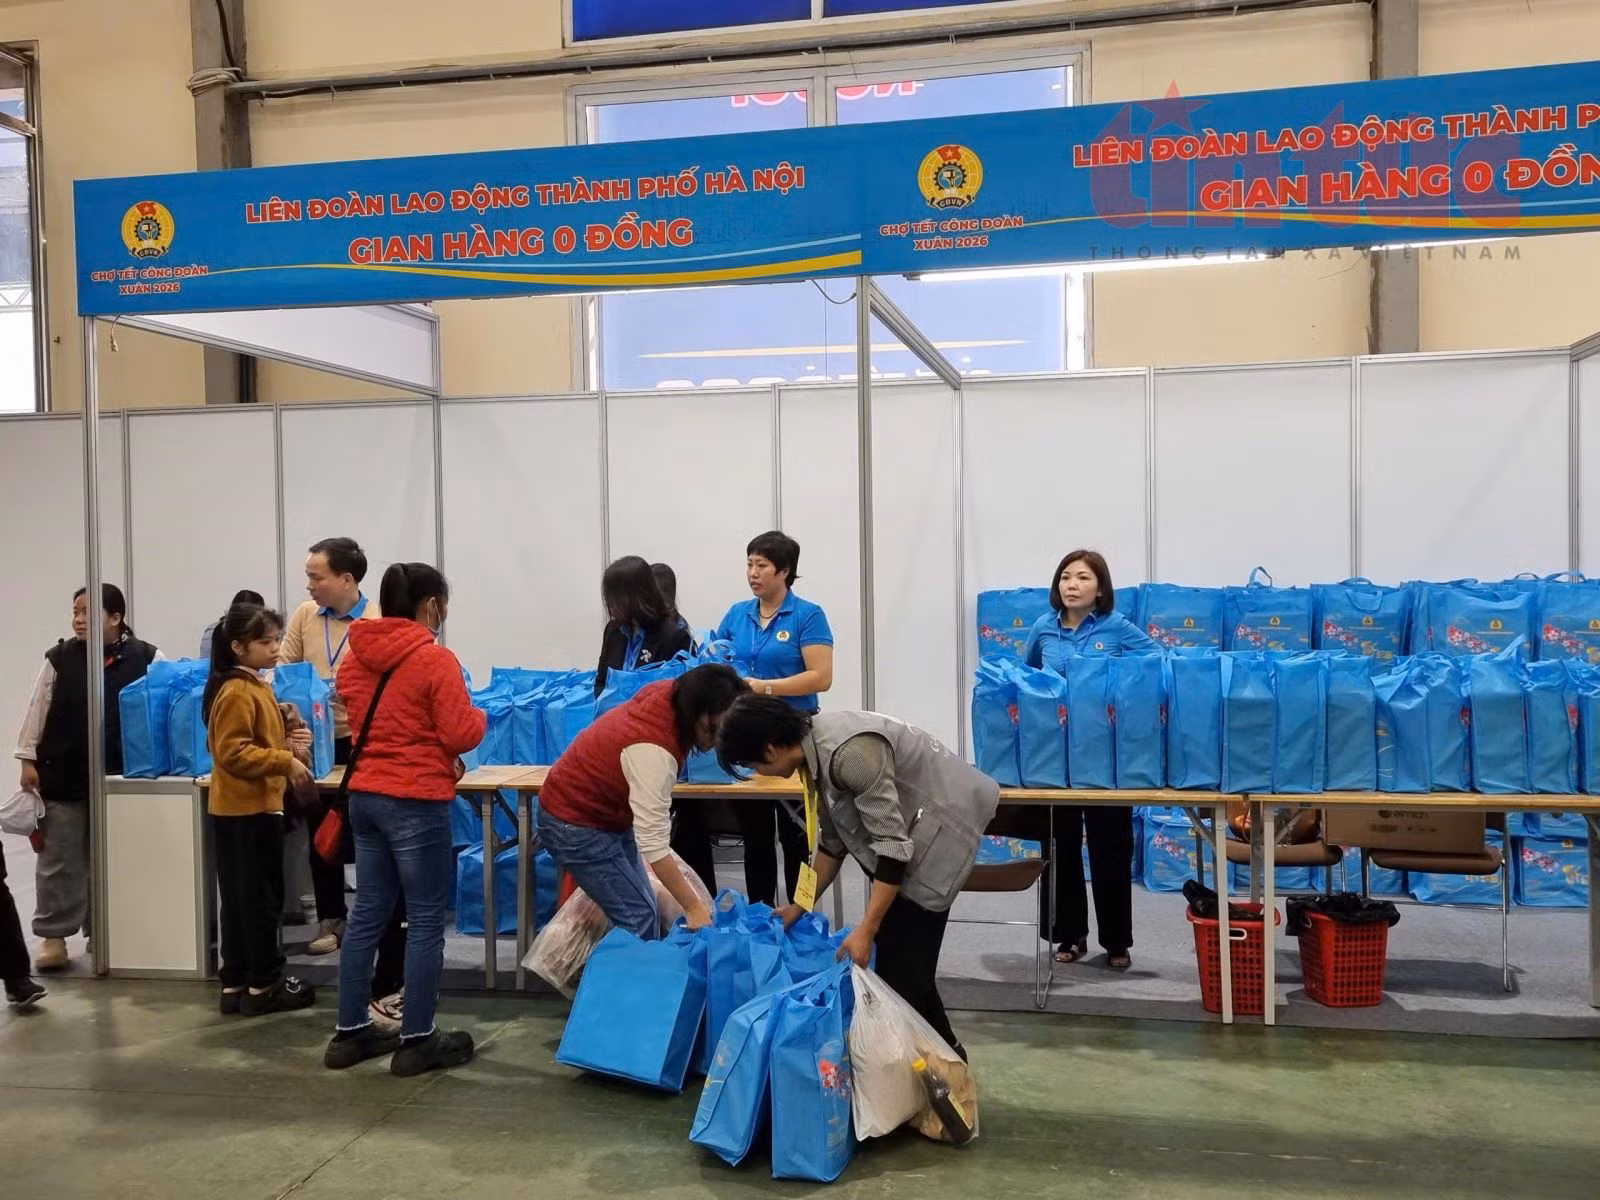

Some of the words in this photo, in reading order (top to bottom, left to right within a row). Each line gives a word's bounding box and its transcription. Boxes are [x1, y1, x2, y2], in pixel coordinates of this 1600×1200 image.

[1073, 136, 1143, 168] LIÊN
[1149, 128, 1247, 162] ĐOÀN
[1256, 126, 1325, 154] LAO
[1331, 115, 1435, 152] ĐỘNG
[1442, 105, 1567, 140] THÀNH
[245, 196, 302, 224] LIÊN
[307, 191, 384, 220] ĐOÀN
[390, 191, 445, 215] LAO
[450, 183, 530, 215] ĐỘNG
[535, 176, 631, 206] THÀNH
[638, 165, 700, 199] PHỐ
[705, 165, 748, 195] HÀ
[753, 161, 805, 195] NỘI
[1200, 174, 1308, 212] GIAN
[1320, 162, 1452, 204] HÀNG
[1463, 160, 1493, 193] 0
[349, 233, 433, 265] GIAN
[442, 224, 544, 260] HÀNG
[553, 225, 576, 253] 0
[584, 212, 694, 252] ĐỒNG
[880, 222, 910, 237] CHỢ
[911, 219, 937, 234] TẾT
[939, 218, 979, 232] CÔNG
[981, 214, 1024, 230] ĐOÀN
[914, 236, 954, 251] XUÂN
[956, 235, 988, 248] 2026
[91, 269, 115, 283] CHỢ
[117, 266, 138, 280] TẾT
[140, 266, 173, 279] CÔNG
[174, 263, 208, 278] ĐOÀN
[118, 281, 151, 295] XUÂN
[152, 282, 180, 294] 2026
